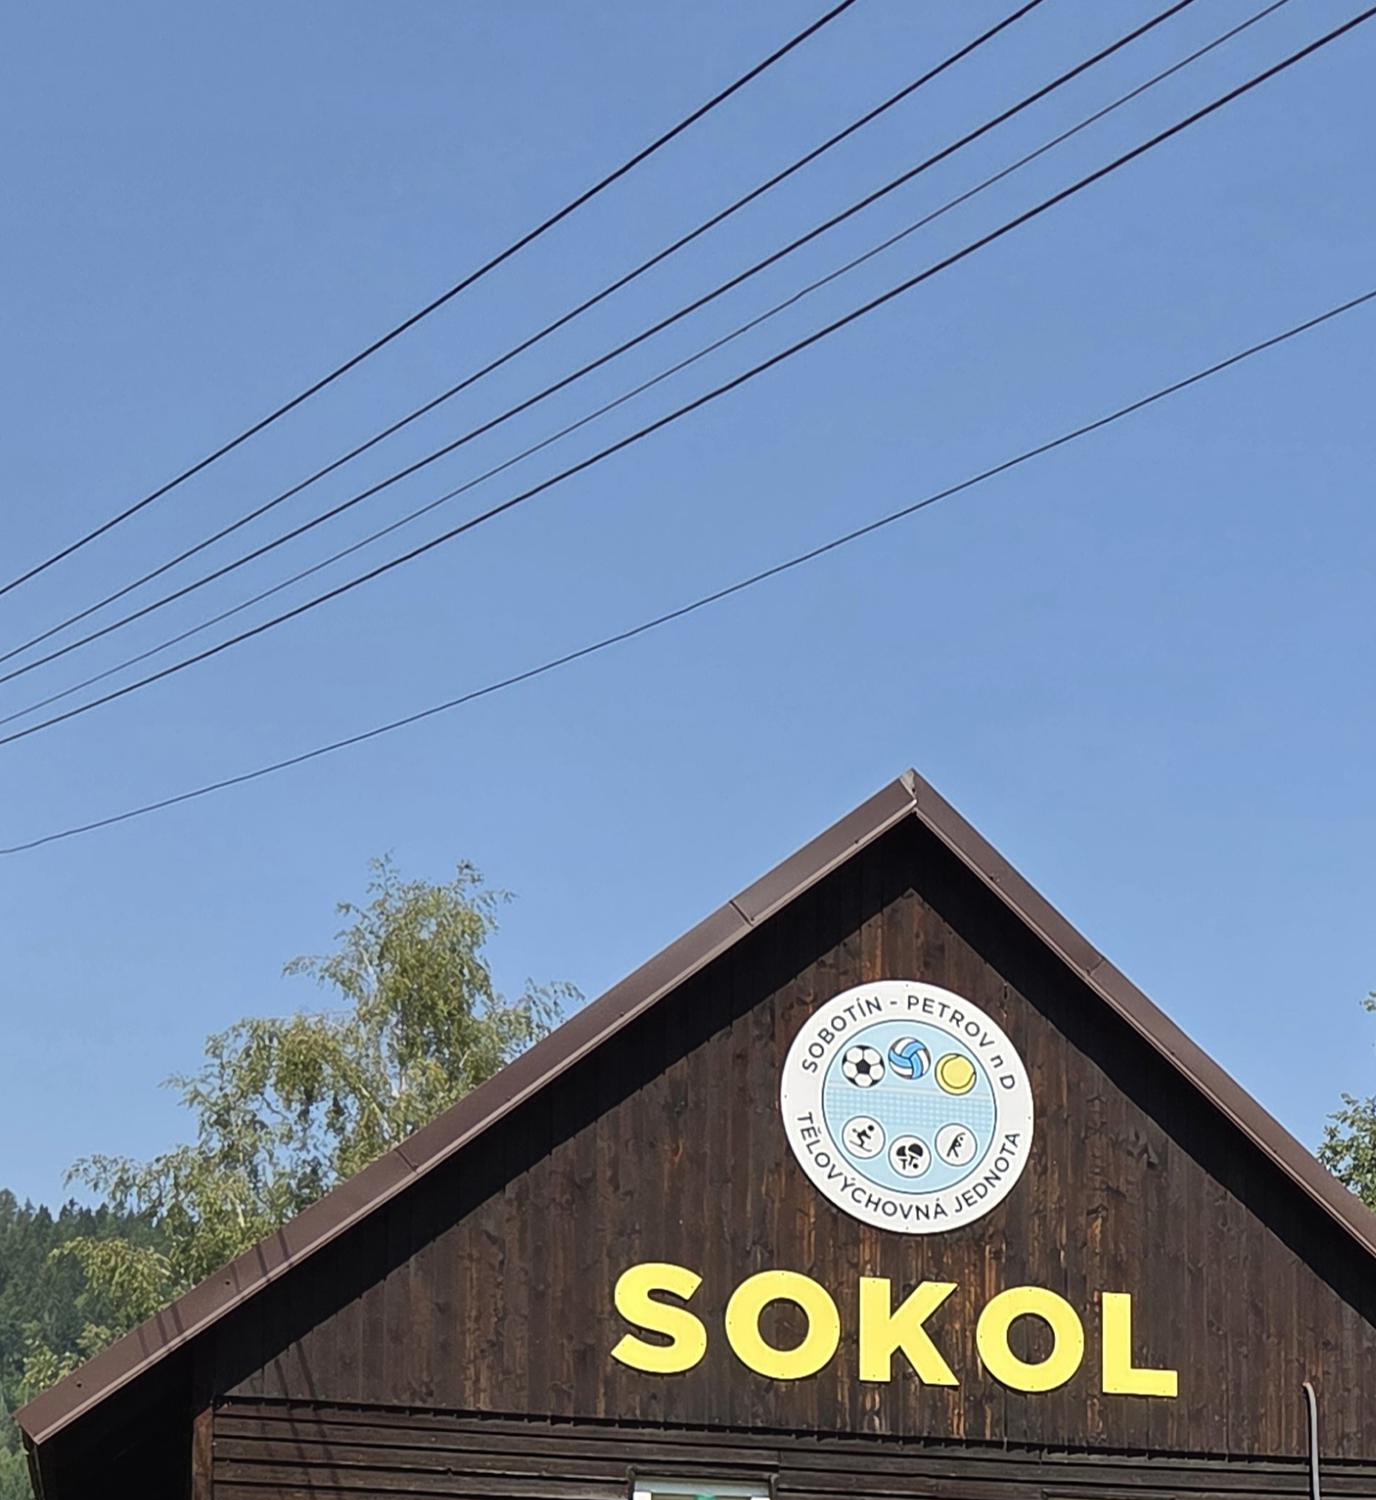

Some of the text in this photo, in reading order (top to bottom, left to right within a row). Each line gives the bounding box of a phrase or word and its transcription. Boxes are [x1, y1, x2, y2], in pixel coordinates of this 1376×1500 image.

[802, 996, 883, 1073] SOBOTÍN
[906, 994, 995, 1050] PETROV
[990, 1054, 1005, 1069] n
[999, 1074, 1016, 1090] D
[797, 1111, 1021, 1221] TĚLOVÝCHOVNÁ JEDNOTA
[610, 1262, 1178, 1398] SOKOL
